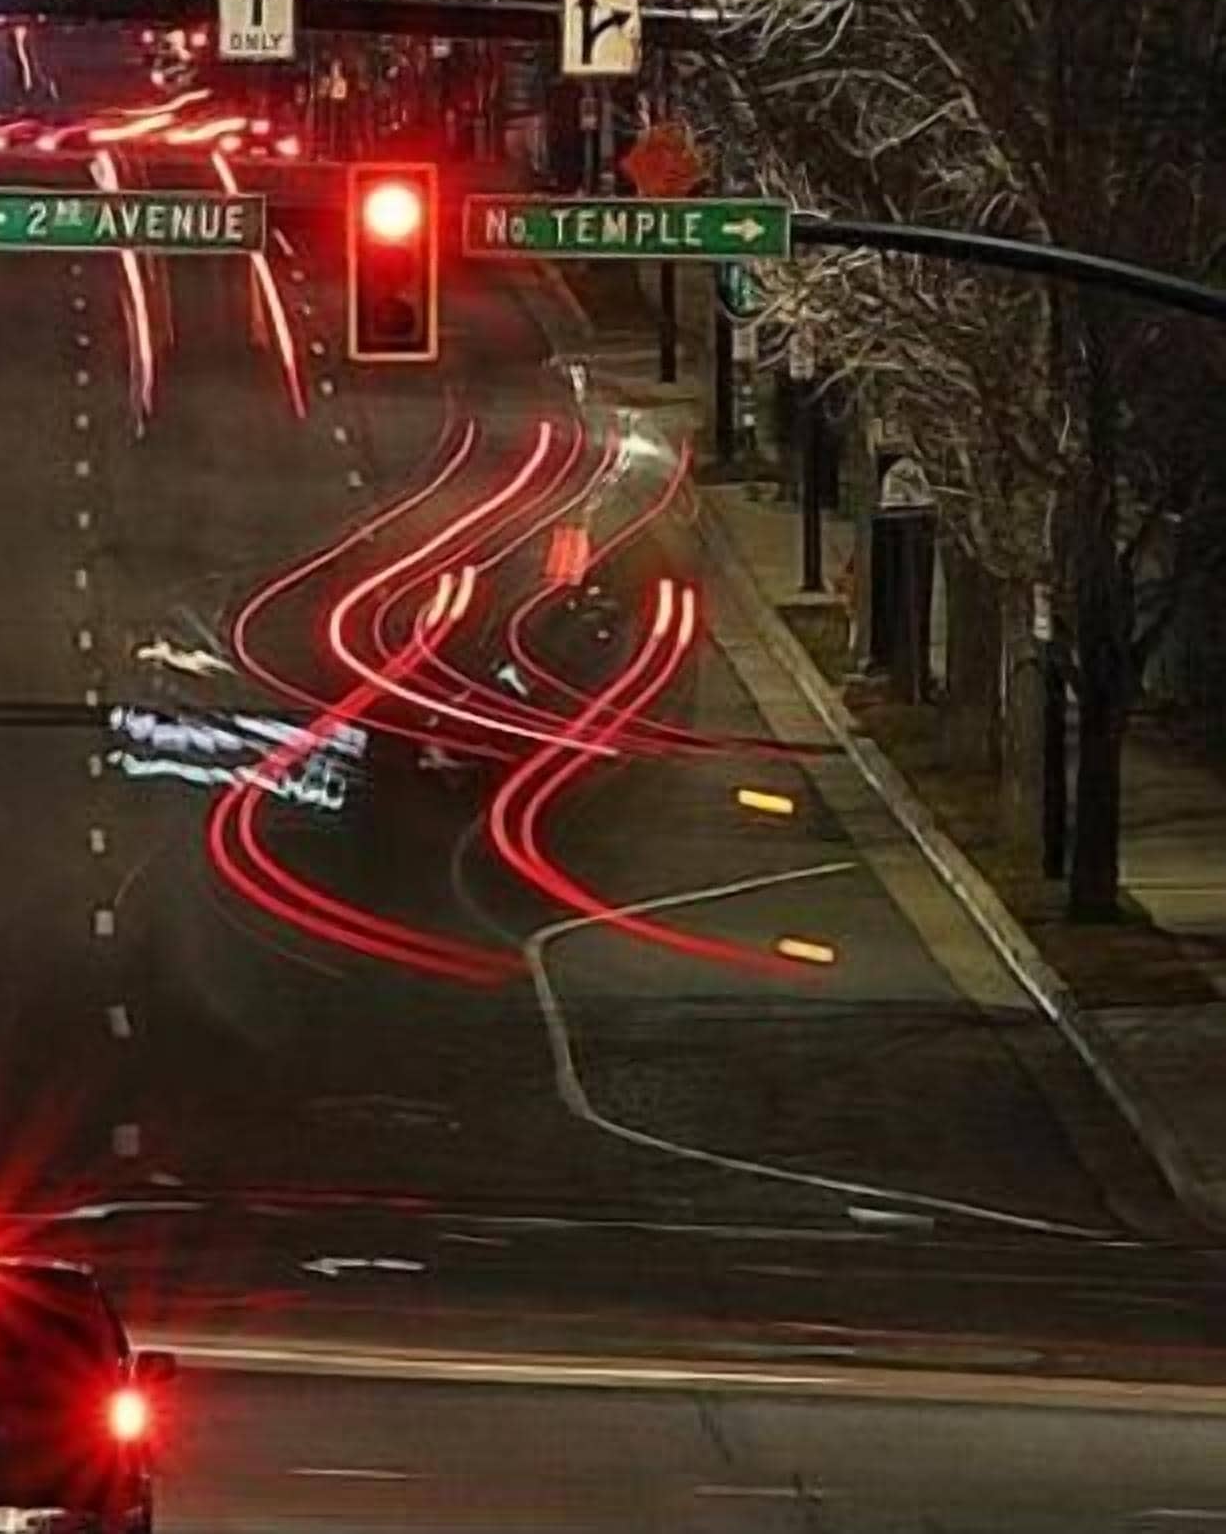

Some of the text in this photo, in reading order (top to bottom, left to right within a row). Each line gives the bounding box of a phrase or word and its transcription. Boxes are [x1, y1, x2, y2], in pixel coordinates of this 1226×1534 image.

[230, 33, 283, 50] ONLY
[95, 202, 244, 241] AVENUE
[551, 208, 703, 246] TEMPLE
